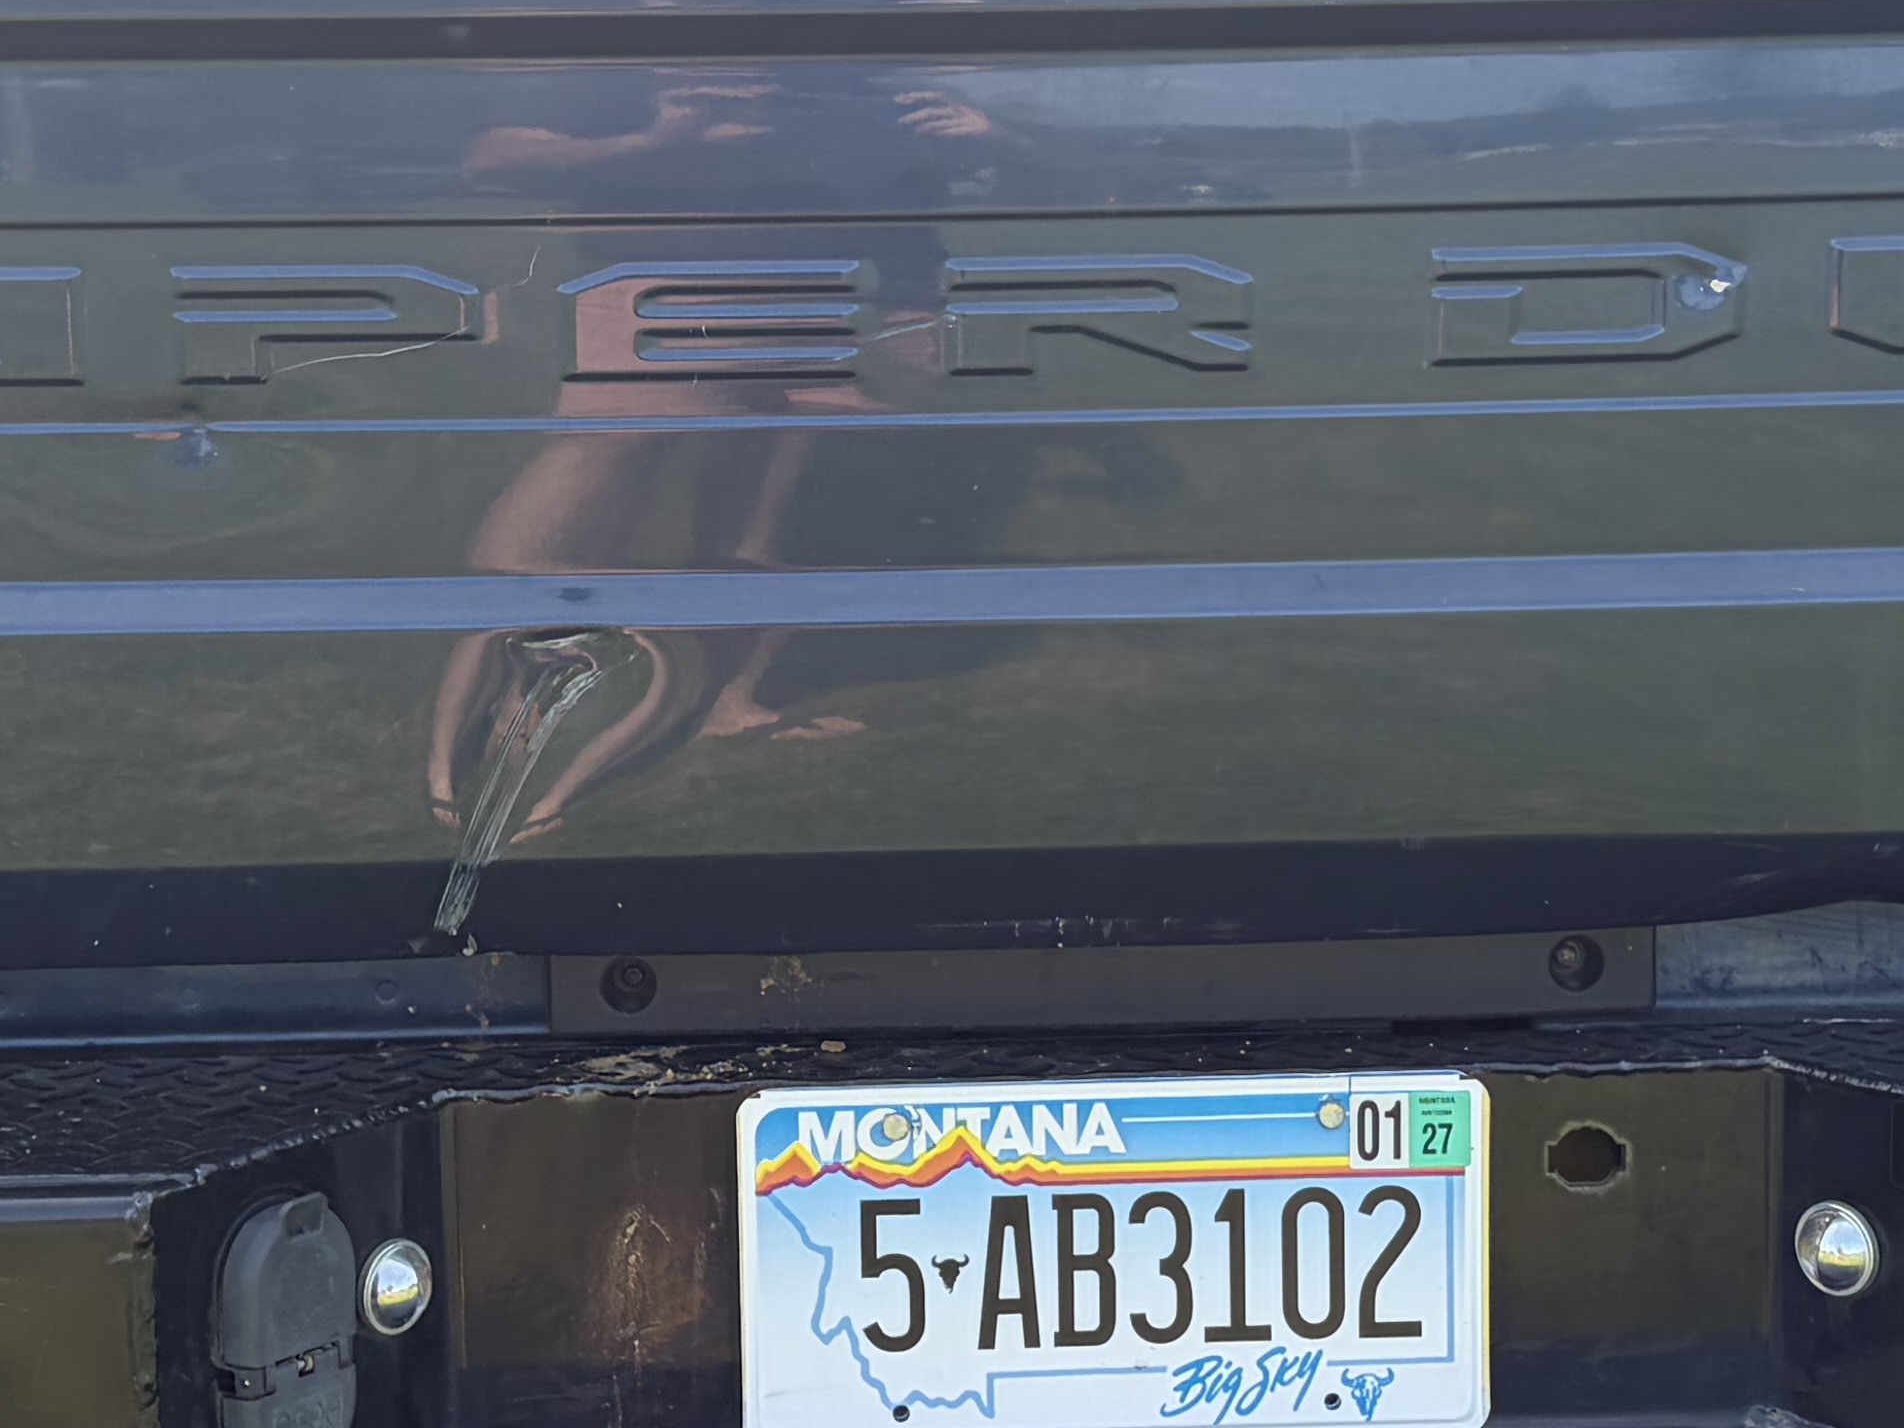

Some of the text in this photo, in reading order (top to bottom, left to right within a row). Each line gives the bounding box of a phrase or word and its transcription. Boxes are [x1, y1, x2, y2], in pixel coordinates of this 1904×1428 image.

[797, 1101, 1128, 1163] MONTANA
[1356, 1099, 1402, 1161] 01
[1421, 1122, 1453, 1155] 27
[859, 1184, 1423, 1353] 5 AB3102
[1160, 1355, 1243, 1425] Big
